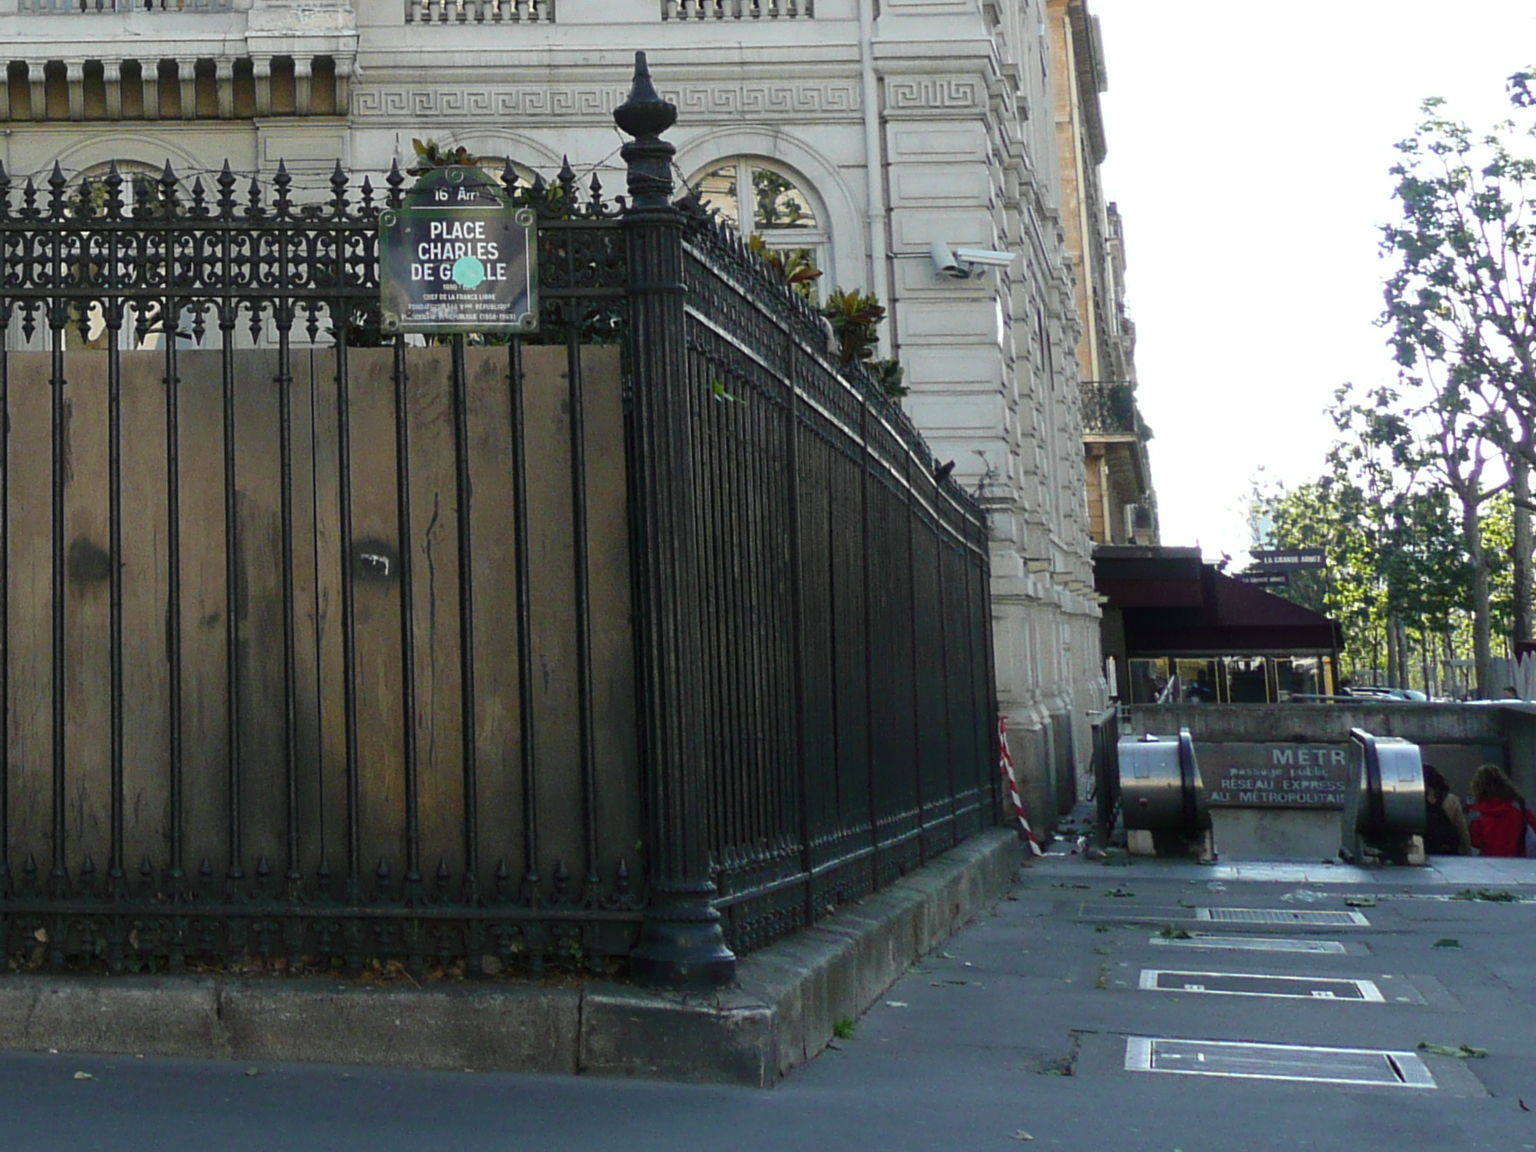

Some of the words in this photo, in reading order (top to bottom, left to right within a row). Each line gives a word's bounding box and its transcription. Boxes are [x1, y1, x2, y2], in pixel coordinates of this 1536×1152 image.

[430, 221, 486, 239] PLACE
[418, 242, 499, 260] CHARLES
[411, 263, 434, 281] DE
[439, 263, 507, 281] GLE
[439, 293, 447, 301] DE
[448, 293, 455, 301] LA
[456, 293, 478, 301] FRANCE
[479, 293, 496, 301] LIBRE
[1264, 556, 1273, 564] LA
